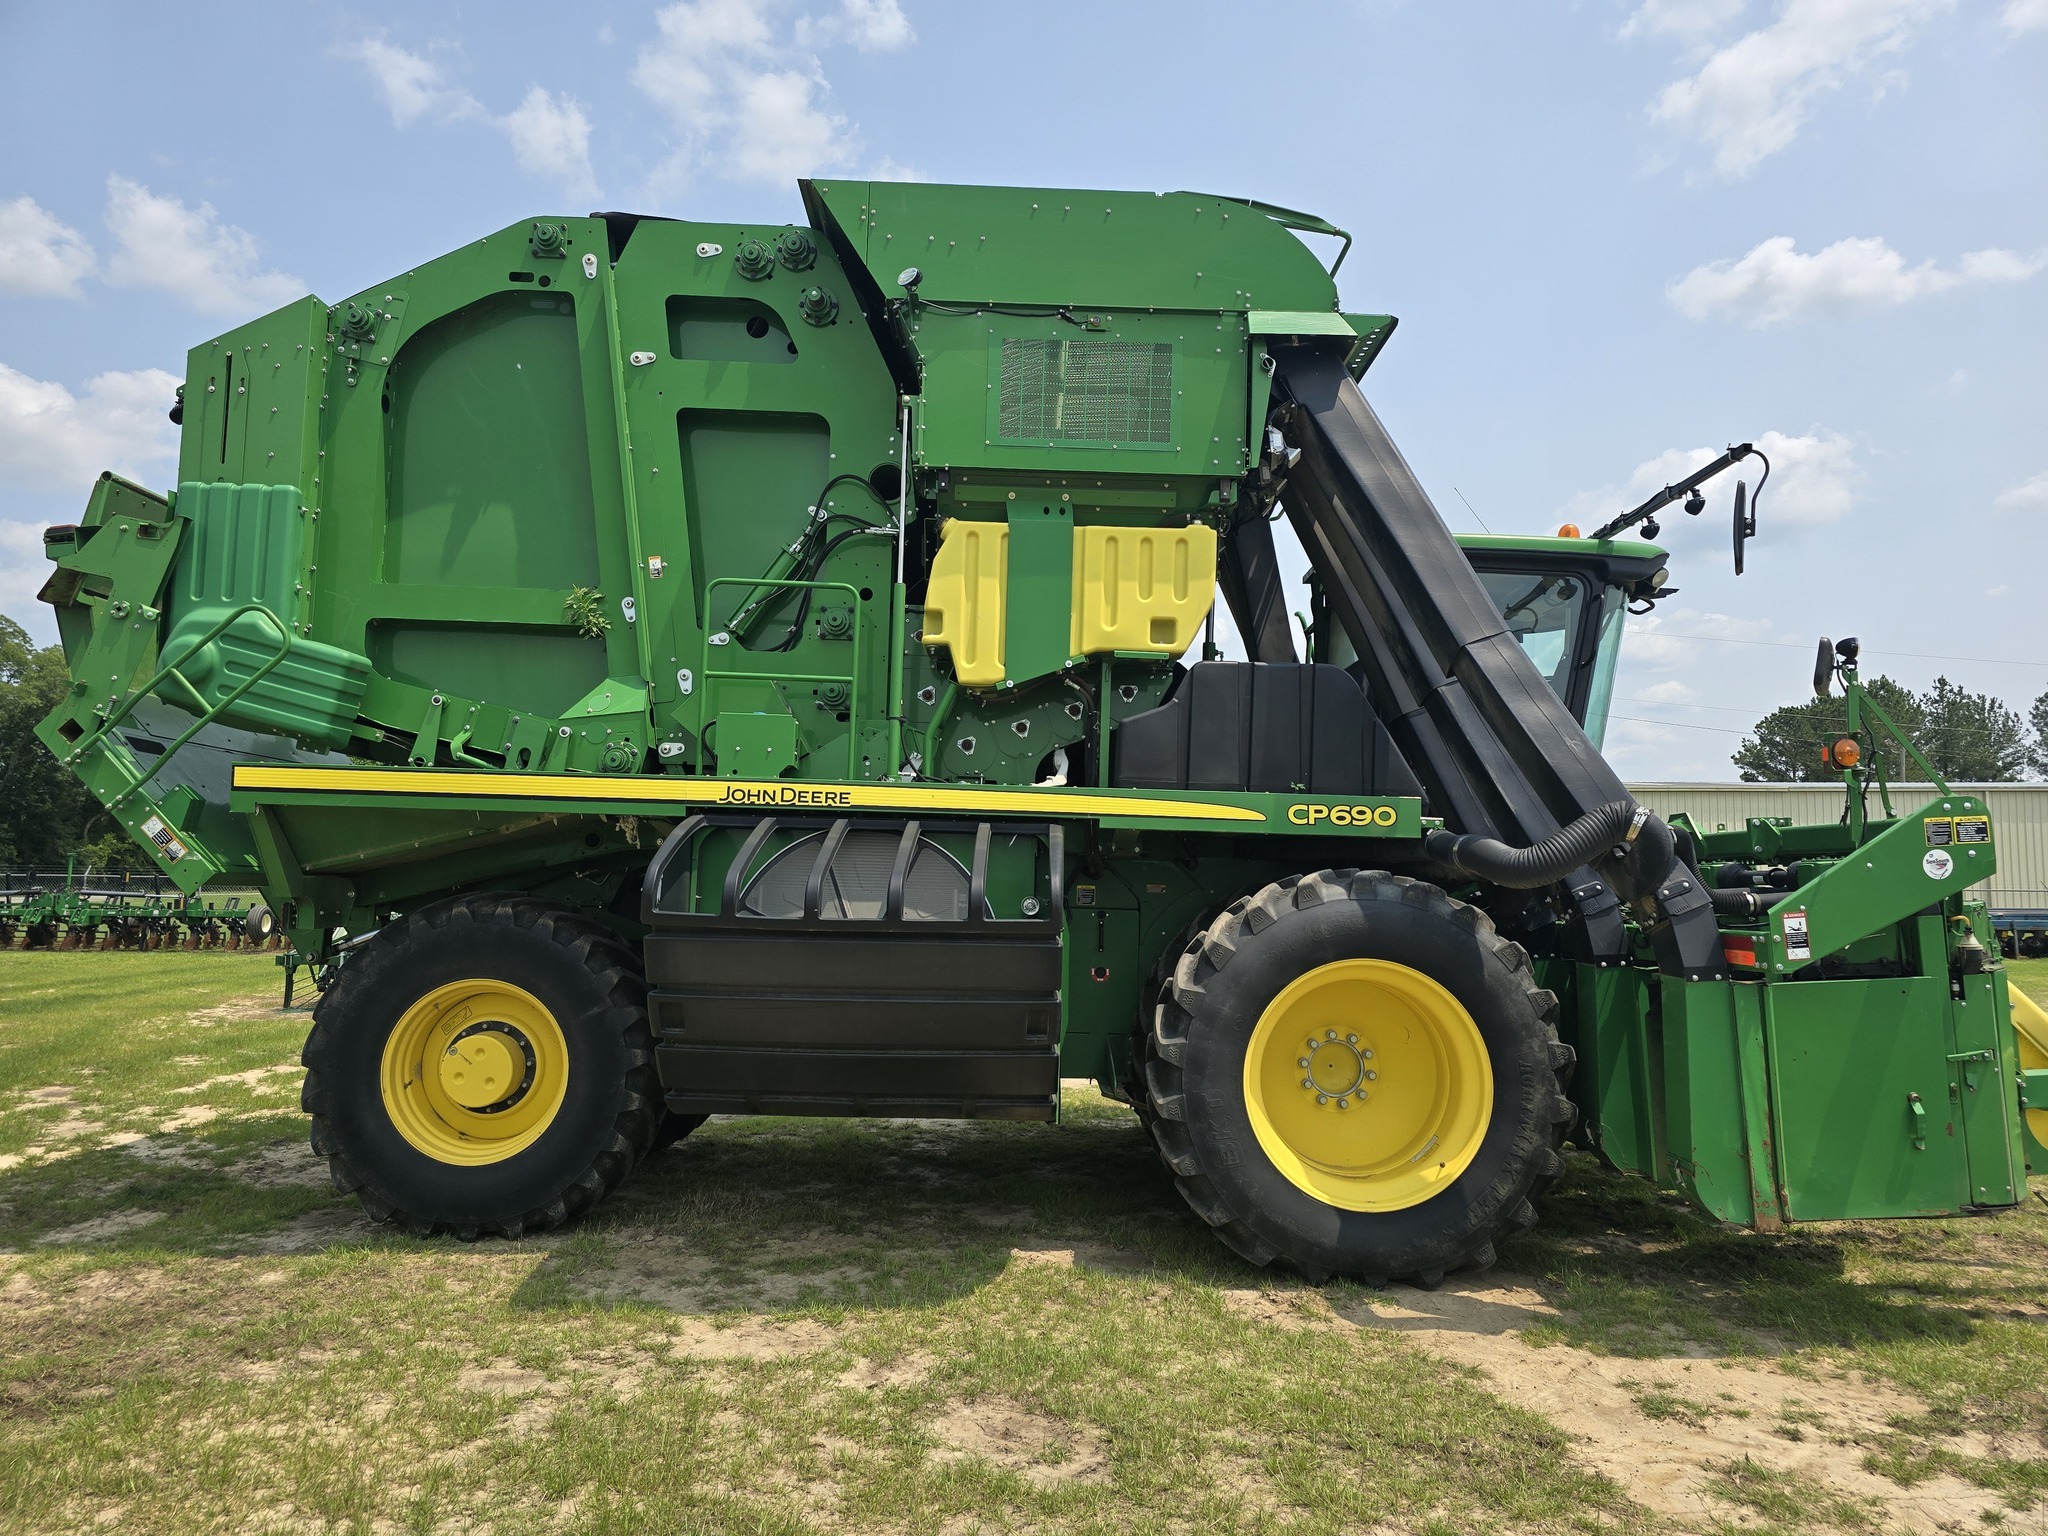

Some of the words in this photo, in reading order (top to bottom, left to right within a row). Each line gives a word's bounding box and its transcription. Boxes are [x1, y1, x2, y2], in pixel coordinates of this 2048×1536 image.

[719, 786, 776, 802] JOHN
[780, 787, 851, 804] DEERE
[1287, 803, 1398, 827] CP690
[1200, 1092, 1241, 1166] BKT
